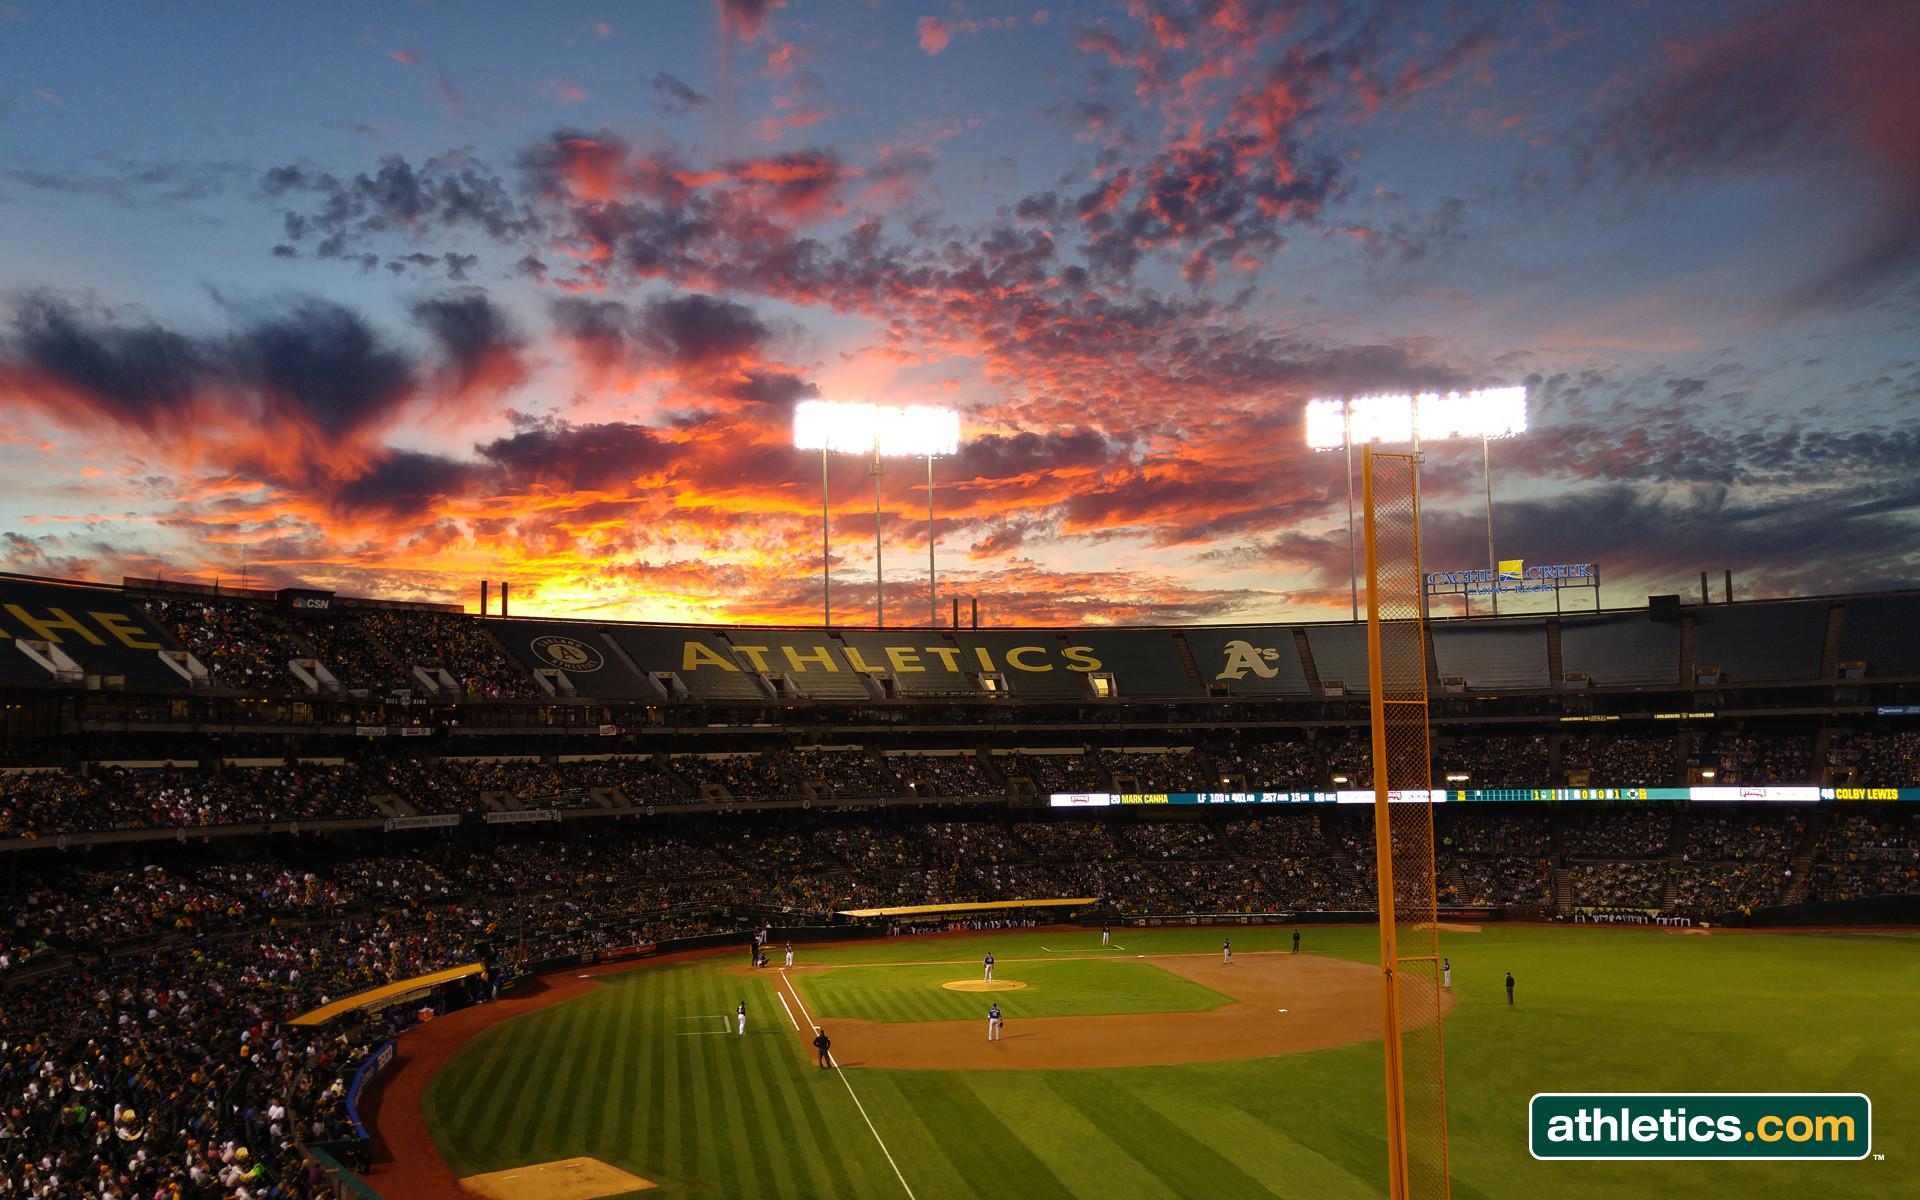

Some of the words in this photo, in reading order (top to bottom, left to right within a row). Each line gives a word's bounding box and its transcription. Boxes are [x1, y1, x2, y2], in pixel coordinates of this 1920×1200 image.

[1428, 568, 1495, 584] CACHE
[1526, 563, 1593, 580] CREEK
[306, 599, 329, 609] CSN
[0, 604, 161, 650] HE
[682, 641, 1102, 672] ATHLETICS
[1111, 794, 1120, 804] 20
[1122, 794, 1143, 804] MARK
[1144, 793, 1168, 804] CANHA
[1197, 793, 1206, 803] LF
[1836, 789, 1865, 799] COLBY
[1867, 788, 1898, 799] LEWIS
